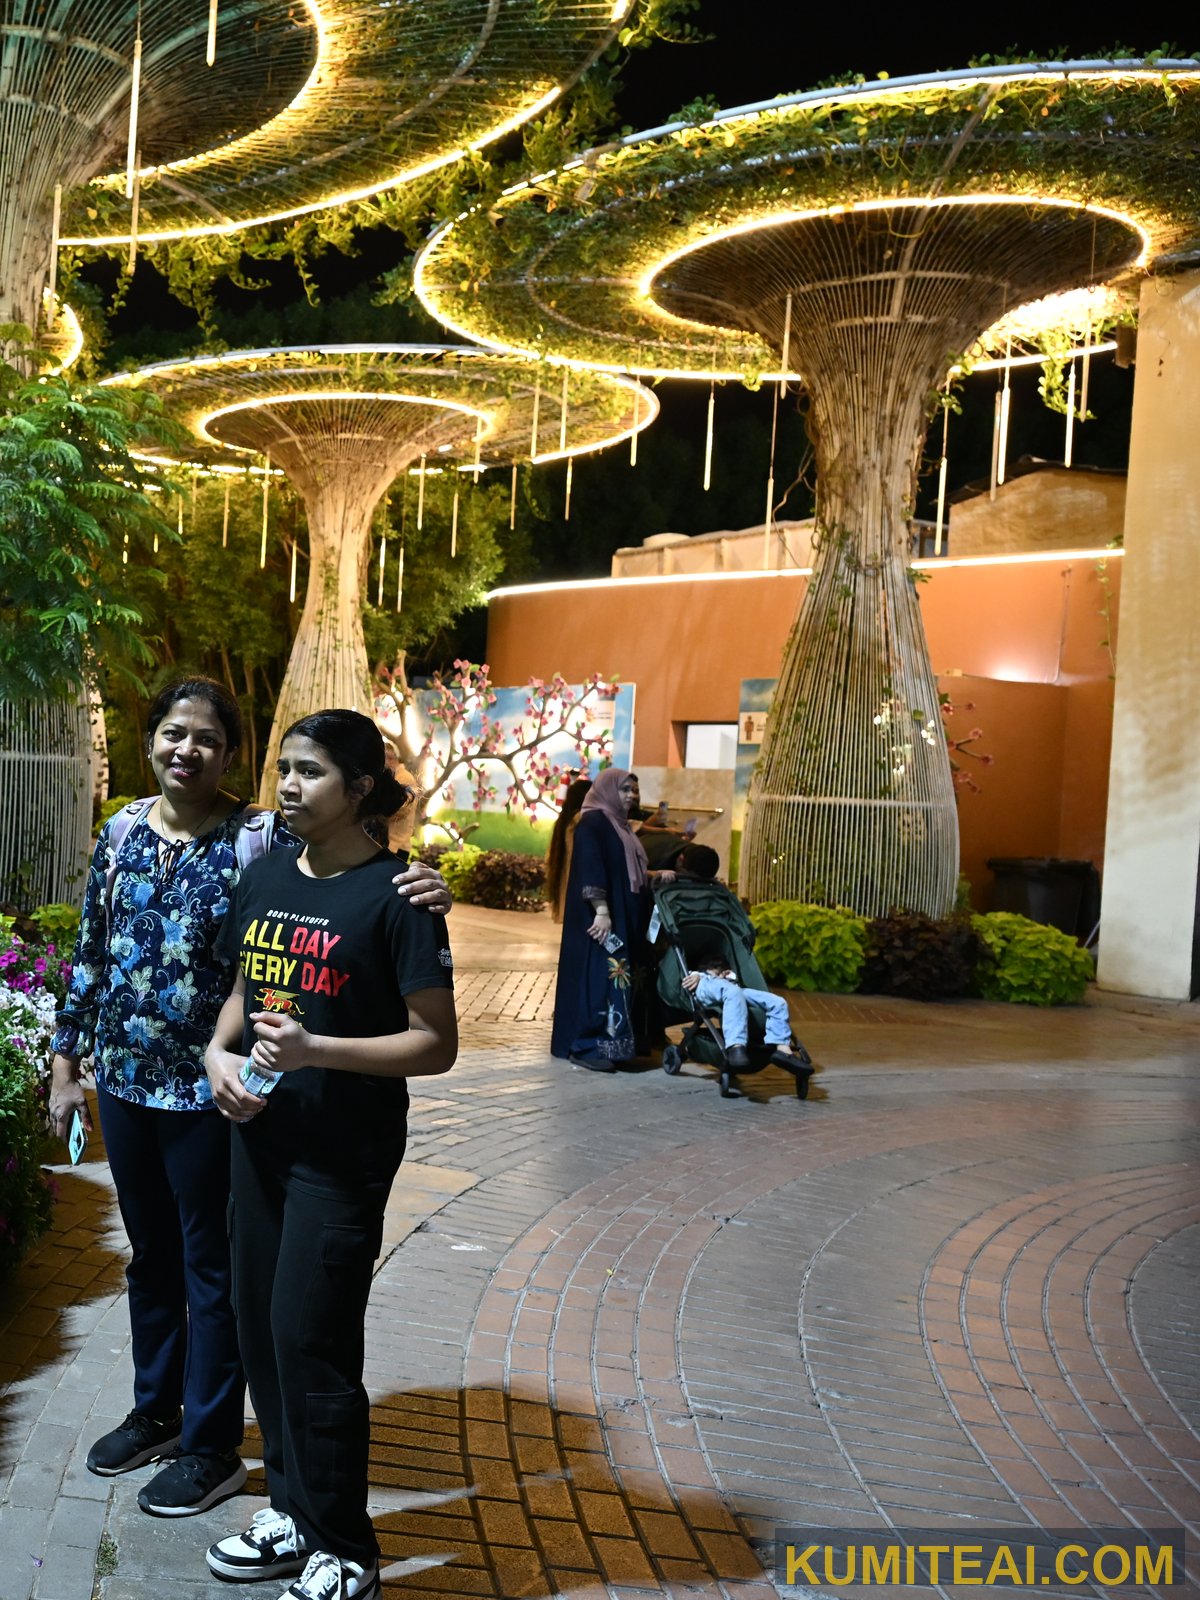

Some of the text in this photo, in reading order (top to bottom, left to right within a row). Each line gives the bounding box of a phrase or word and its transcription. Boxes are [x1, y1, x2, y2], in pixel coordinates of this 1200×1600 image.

[290, 913, 330, 926] PLAYOFFS
[243, 919, 342, 960] ALL DAY
[301, 961, 351, 997] DAY
